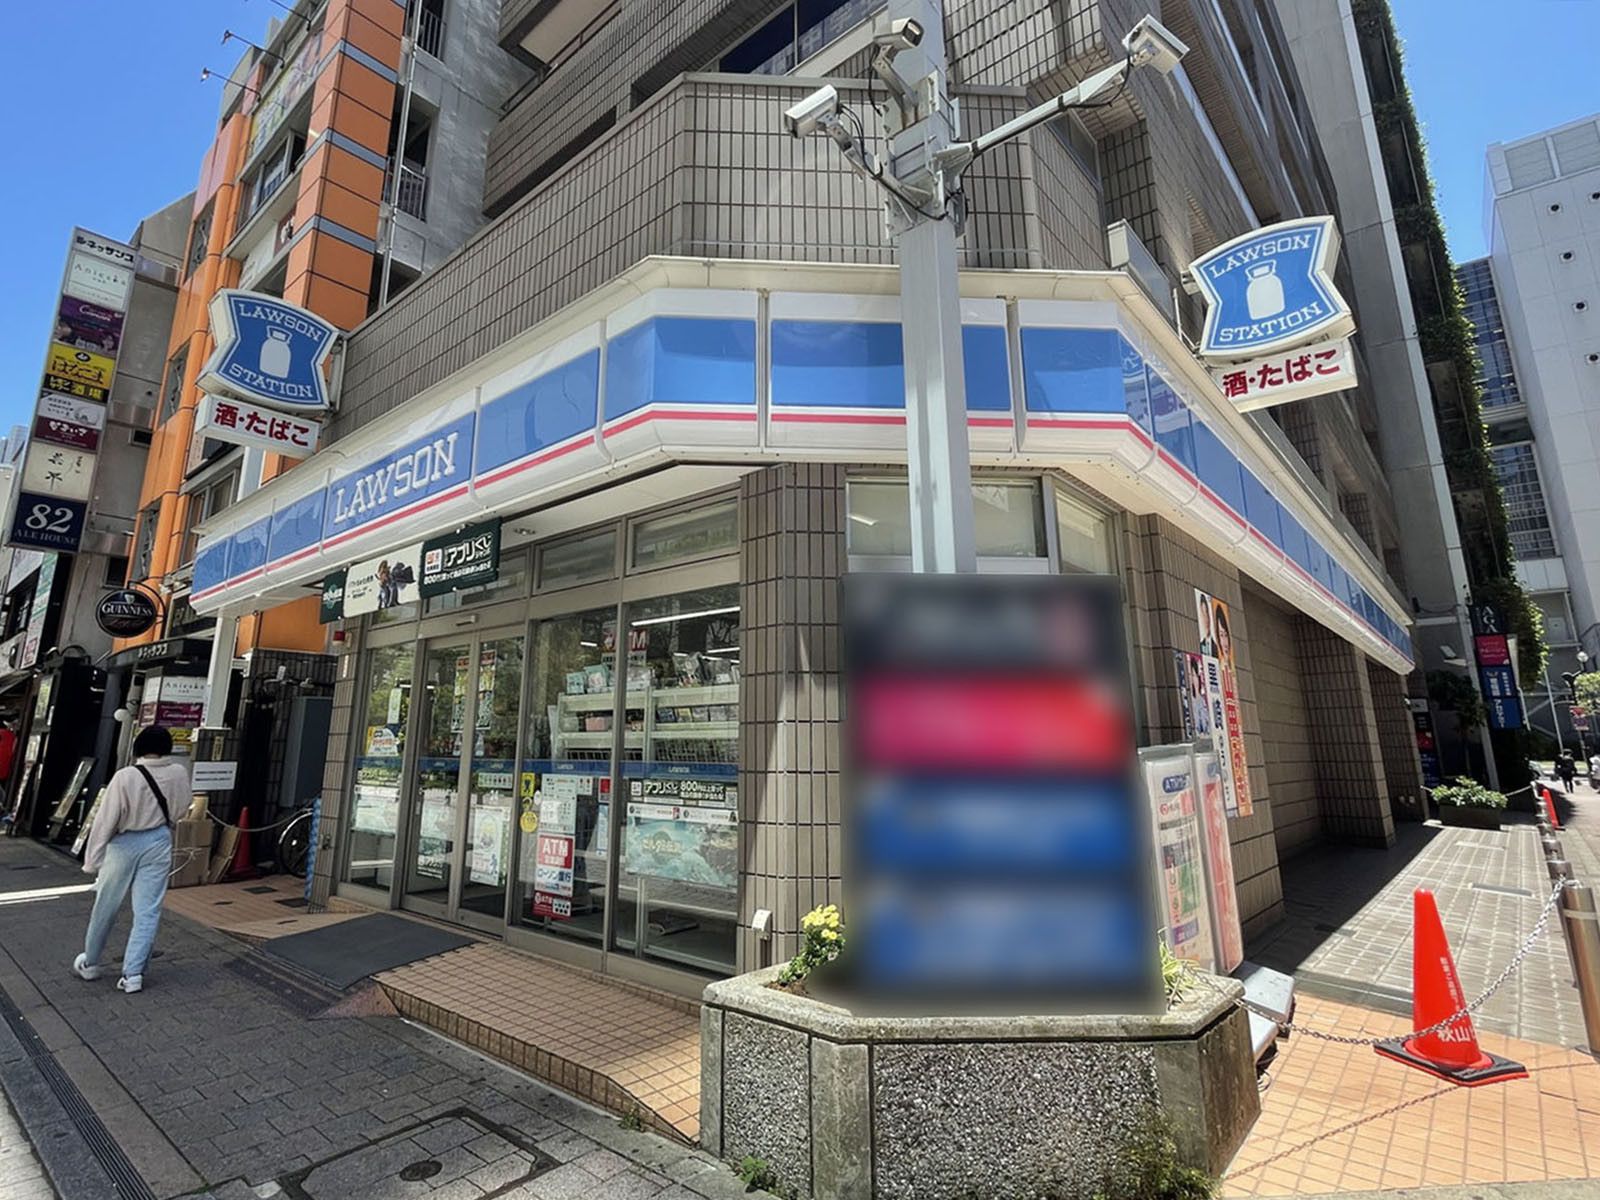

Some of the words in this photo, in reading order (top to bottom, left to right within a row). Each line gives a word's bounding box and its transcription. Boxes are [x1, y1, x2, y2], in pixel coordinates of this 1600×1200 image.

[1208, 233, 1314, 279] LAWSON
[238, 303, 323, 342] LAWSON
[1218, 301, 1324, 343] STATION
[228, 362, 314, 399] STATION
[1222, 349, 1341, 398] 酒・たばこ
[214, 402, 311, 447] 酒・たばこ
[333, 431, 459, 525] LAWSON
[25, 503, 74, 533] 82
[101, 602, 153, 616] GUINNESS
[541, 839, 569, 856] ATM
